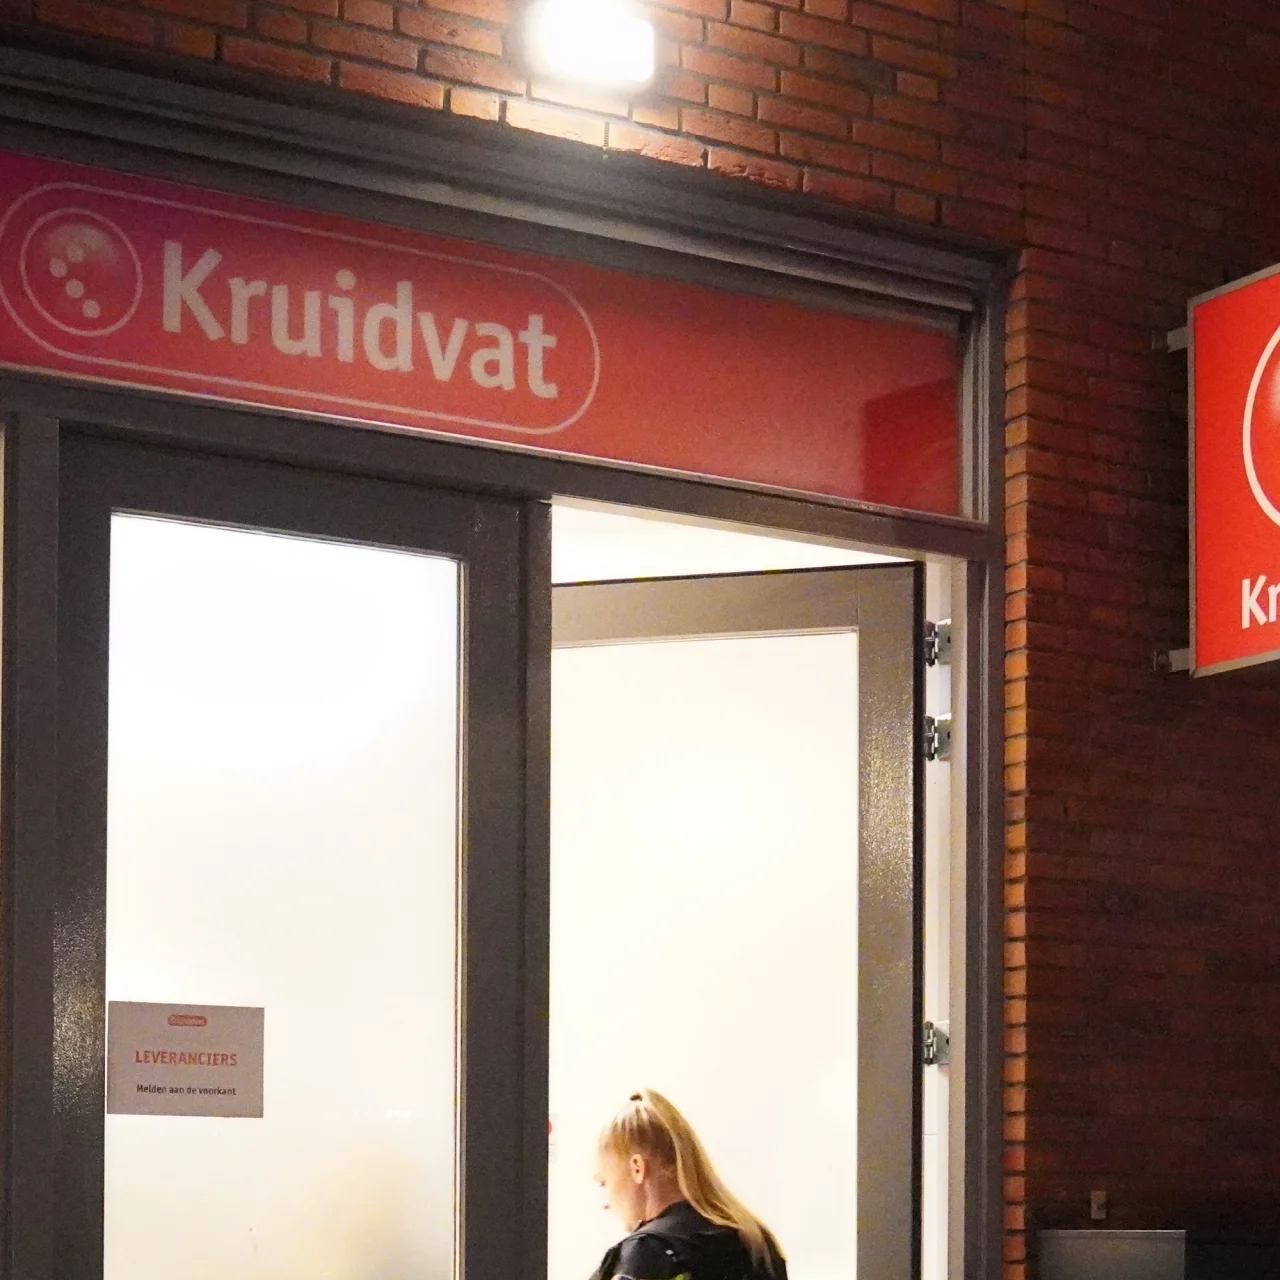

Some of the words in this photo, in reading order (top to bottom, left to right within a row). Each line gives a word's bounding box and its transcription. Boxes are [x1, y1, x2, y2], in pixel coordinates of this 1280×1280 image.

[162, 240, 559, 399] Kruidvat
[135, 1049, 238, 1067] LEVERANCIERS
[136, 1084, 167, 1095] Melden
[169, 1086, 185, 1095] aan
[186, 1085, 197, 1095] de
[198, 1086, 237, 1096] voorkant
